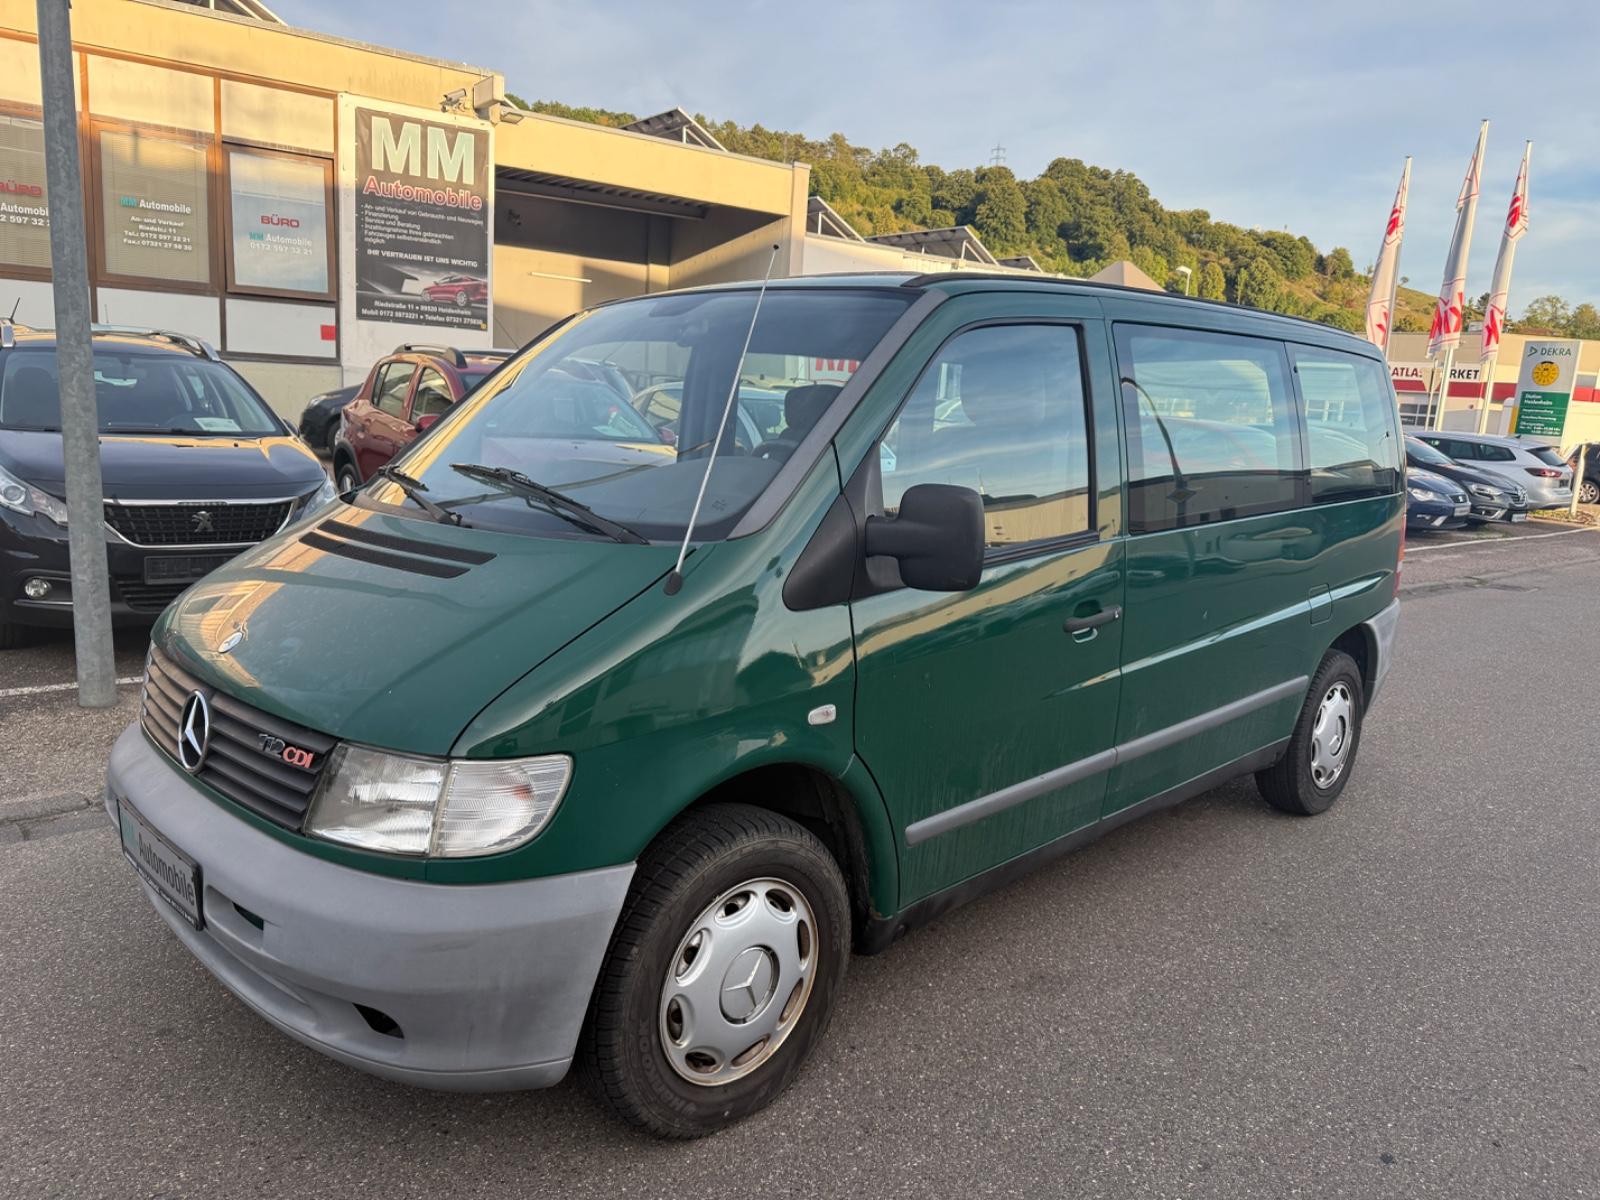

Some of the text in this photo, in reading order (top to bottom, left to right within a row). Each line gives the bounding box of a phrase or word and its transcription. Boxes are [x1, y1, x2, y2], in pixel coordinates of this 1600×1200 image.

[371, 116, 475, 185] MM
[363, 176, 483, 211] Automobile
[0, 202, 49, 217] Automobi
[140, 199, 191, 214] Automobile
[10, 215, 29, 224] 597
[31, 217, 44, 226] 32
[260, 213, 300, 228] BÜRO
[265, 233, 313, 247] Automobile
[367, 249, 380, 257] IHR
[380, 250, 423, 262] VERTRAUEN
[450, 259, 478, 268] WICHTIG
[361, 308, 379, 316] Mobil
[379, 309, 393, 317] 0172
[1540, 347, 1572, 357] DEKRA
[1449, 368, 1480, 379] RKET
[138, 831, 196, 906] Automobile
